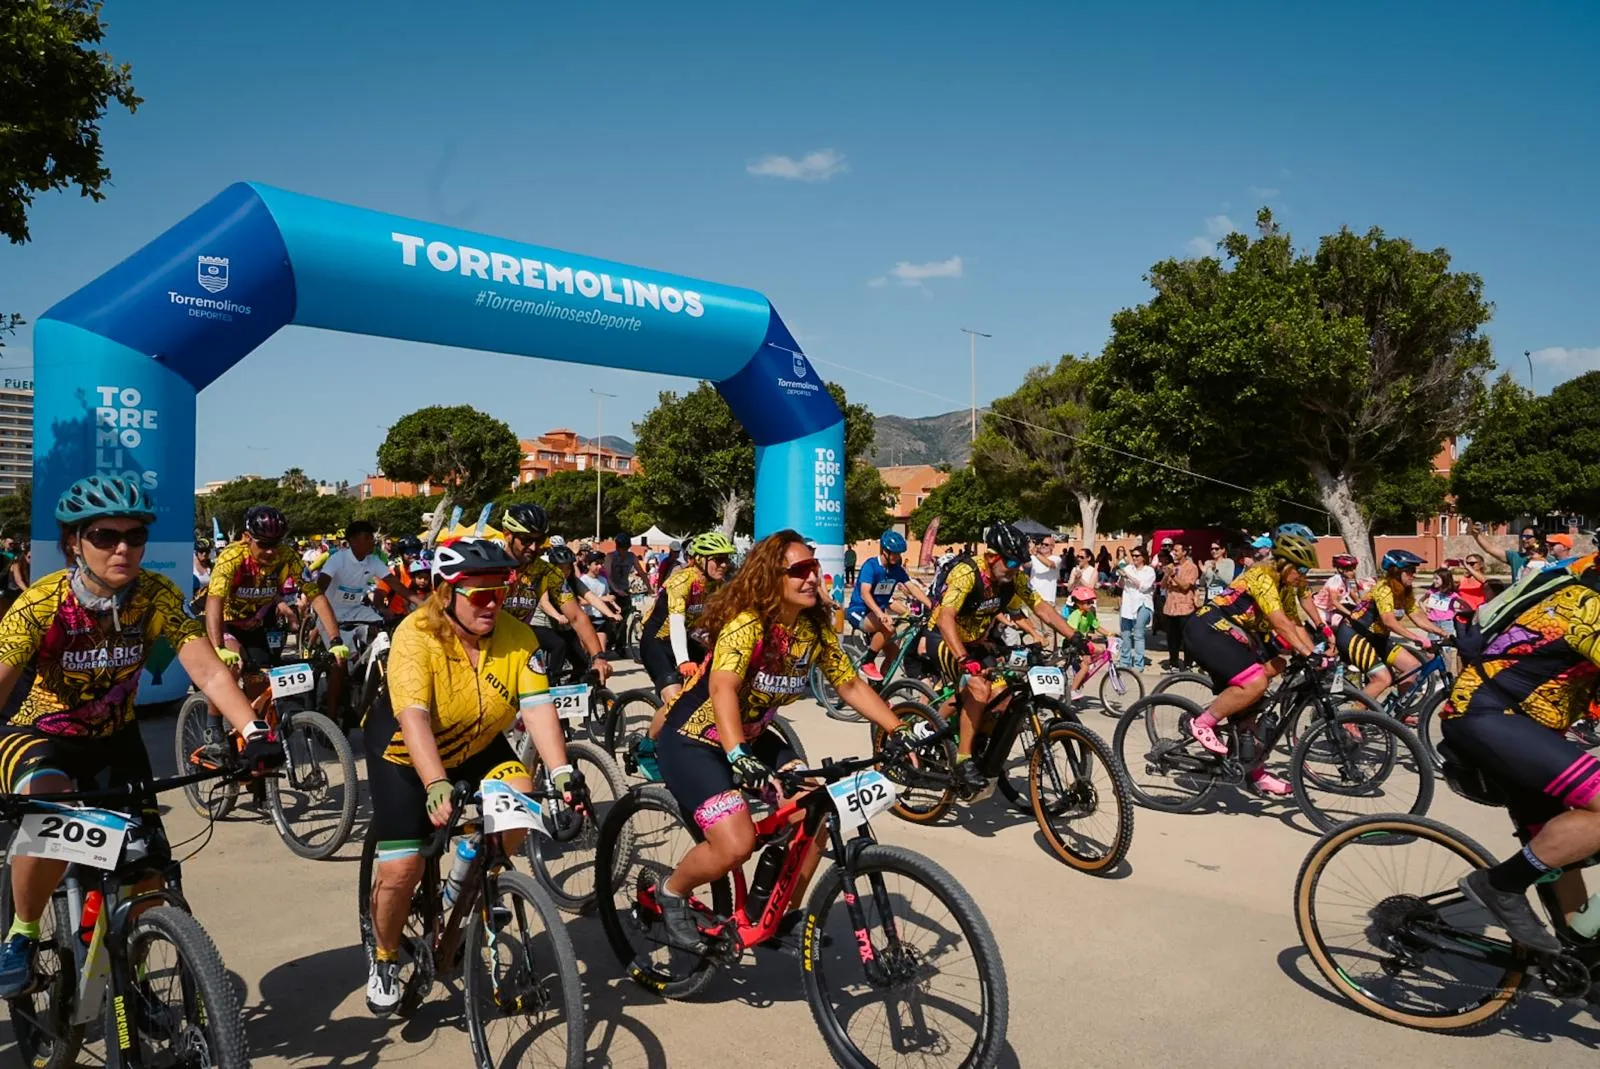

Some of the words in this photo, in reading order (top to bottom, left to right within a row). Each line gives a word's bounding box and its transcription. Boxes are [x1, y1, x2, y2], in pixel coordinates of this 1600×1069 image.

[391, 231, 705, 318] TORREMOLINOS
[168, 291, 252, 315] Torremolinos
[475, 290, 642, 332] #TorremolinosesDeporte
[188, 308, 233, 322] DEPORTES
[777, 377, 819, 392] Torremolinos
[96, 386, 141, 407] TO
[96, 407, 158, 429] RRE
[96, 428, 141, 448] MO
[96, 449, 123, 468] LI
[815, 448, 835, 461] TO
[815, 461, 840, 475] RRE
[815, 474, 835, 487] MO
[815, 487, 829, 499] LI
[815, 499, 841, 512] NOS
[63, 648, 109, 663] RUTA
[113, 643, 144, 660] BICI
[278, 673, 307, 687] 519
[485, 672, 510, 701] RUTA
[754, 671, 788, 687] RUTA
[1037, 675, 1060, 685] 509
[553, 696, 580, 709] 621
[493, 765, 524, 780] UTA
[846, 784, 888, 812] 502
[37, 816, 107, 848] 209
[93, 854, 107, 862] 209
[804, 914, 816, 972] MAXXIS
[855, 928, 874, 964] FOX
